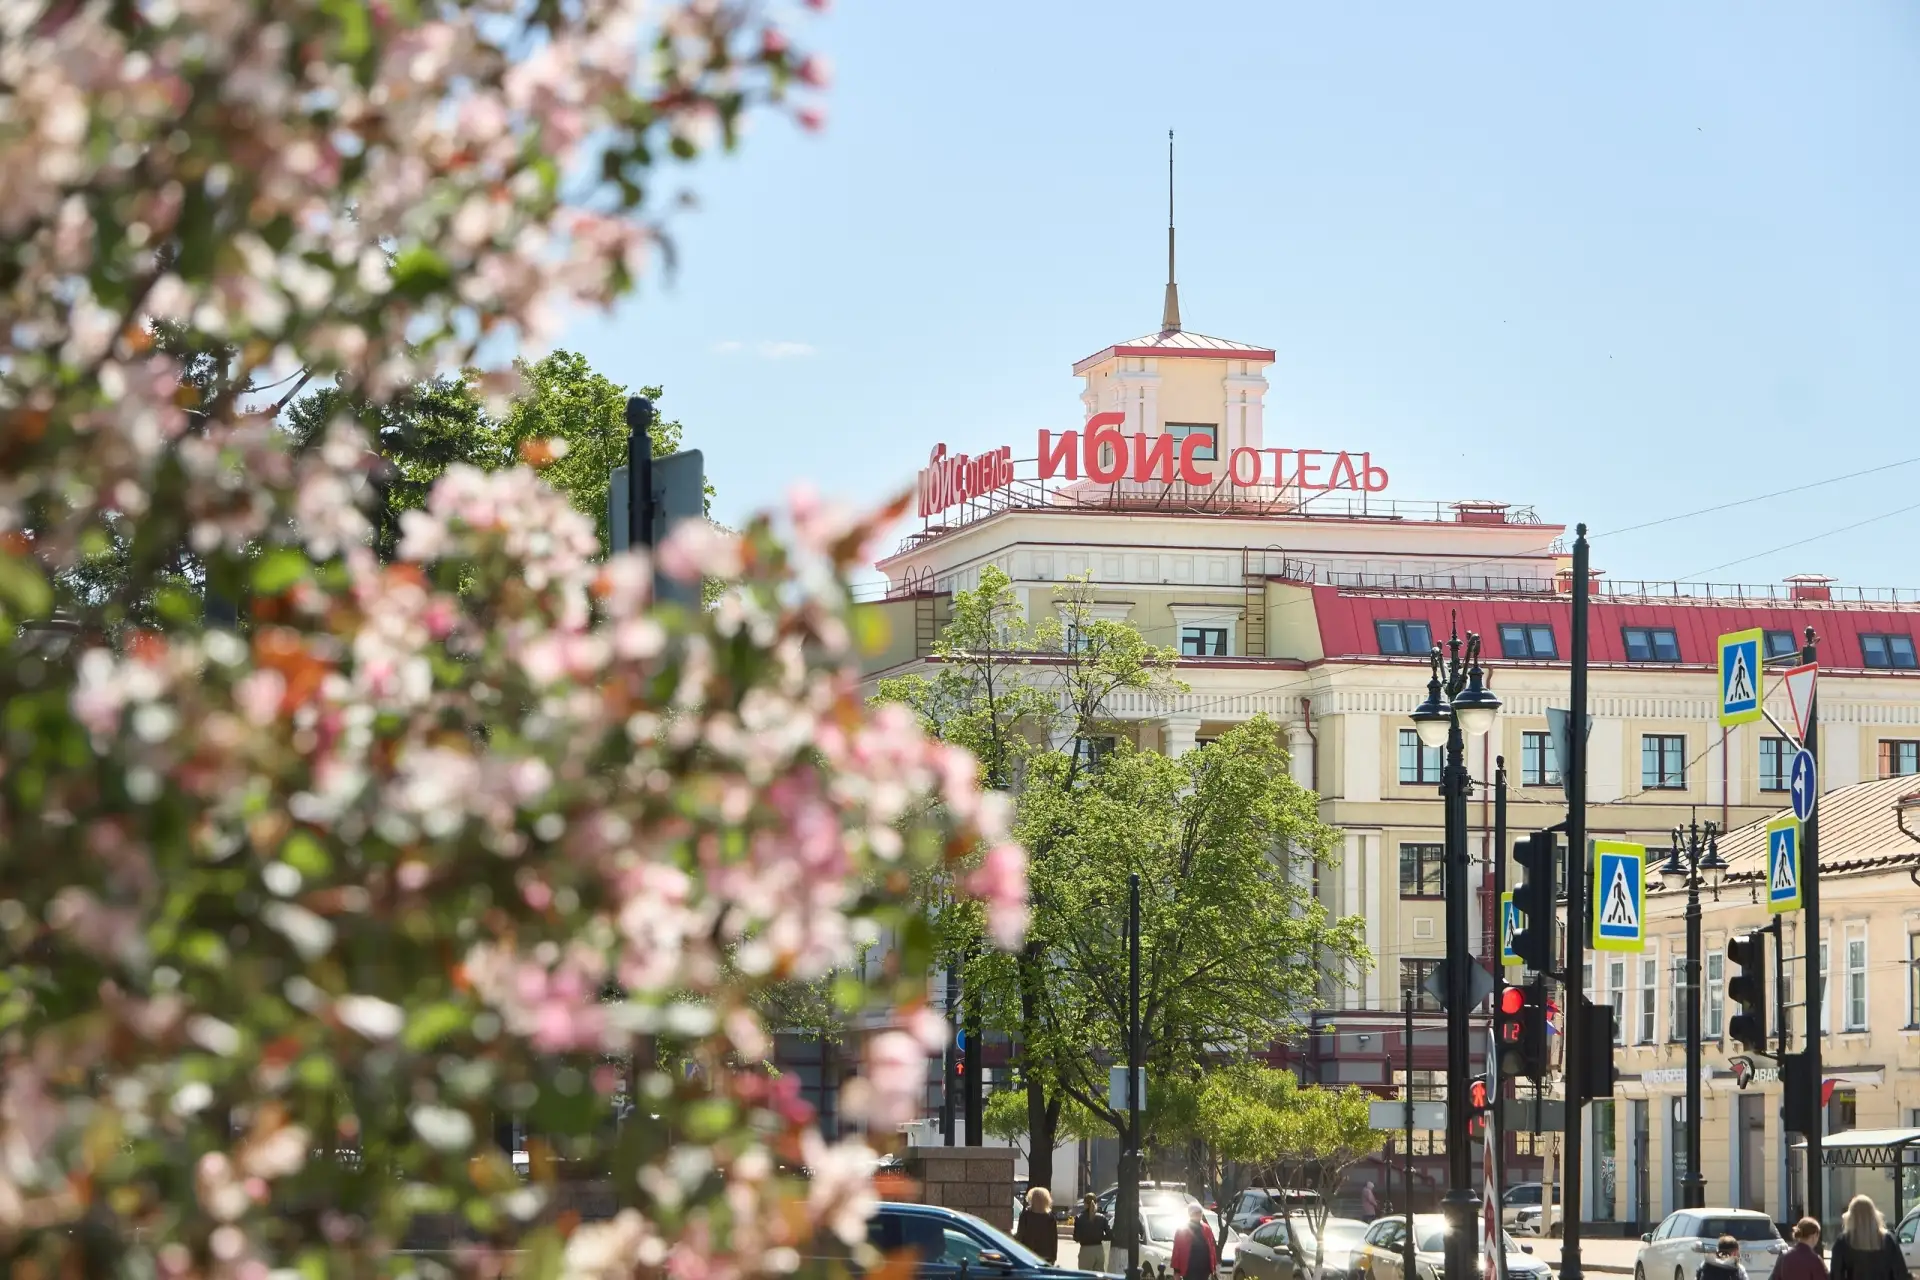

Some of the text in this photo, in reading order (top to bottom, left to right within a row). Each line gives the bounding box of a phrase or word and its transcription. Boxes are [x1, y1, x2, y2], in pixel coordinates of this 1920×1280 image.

[918, 443, 1014, 518] ибис ОТЕЛЬ
[1037, 411, 1389, 492] ибис ОТЕЛЬ
[1503, 1023, 1520, 1041] 12
